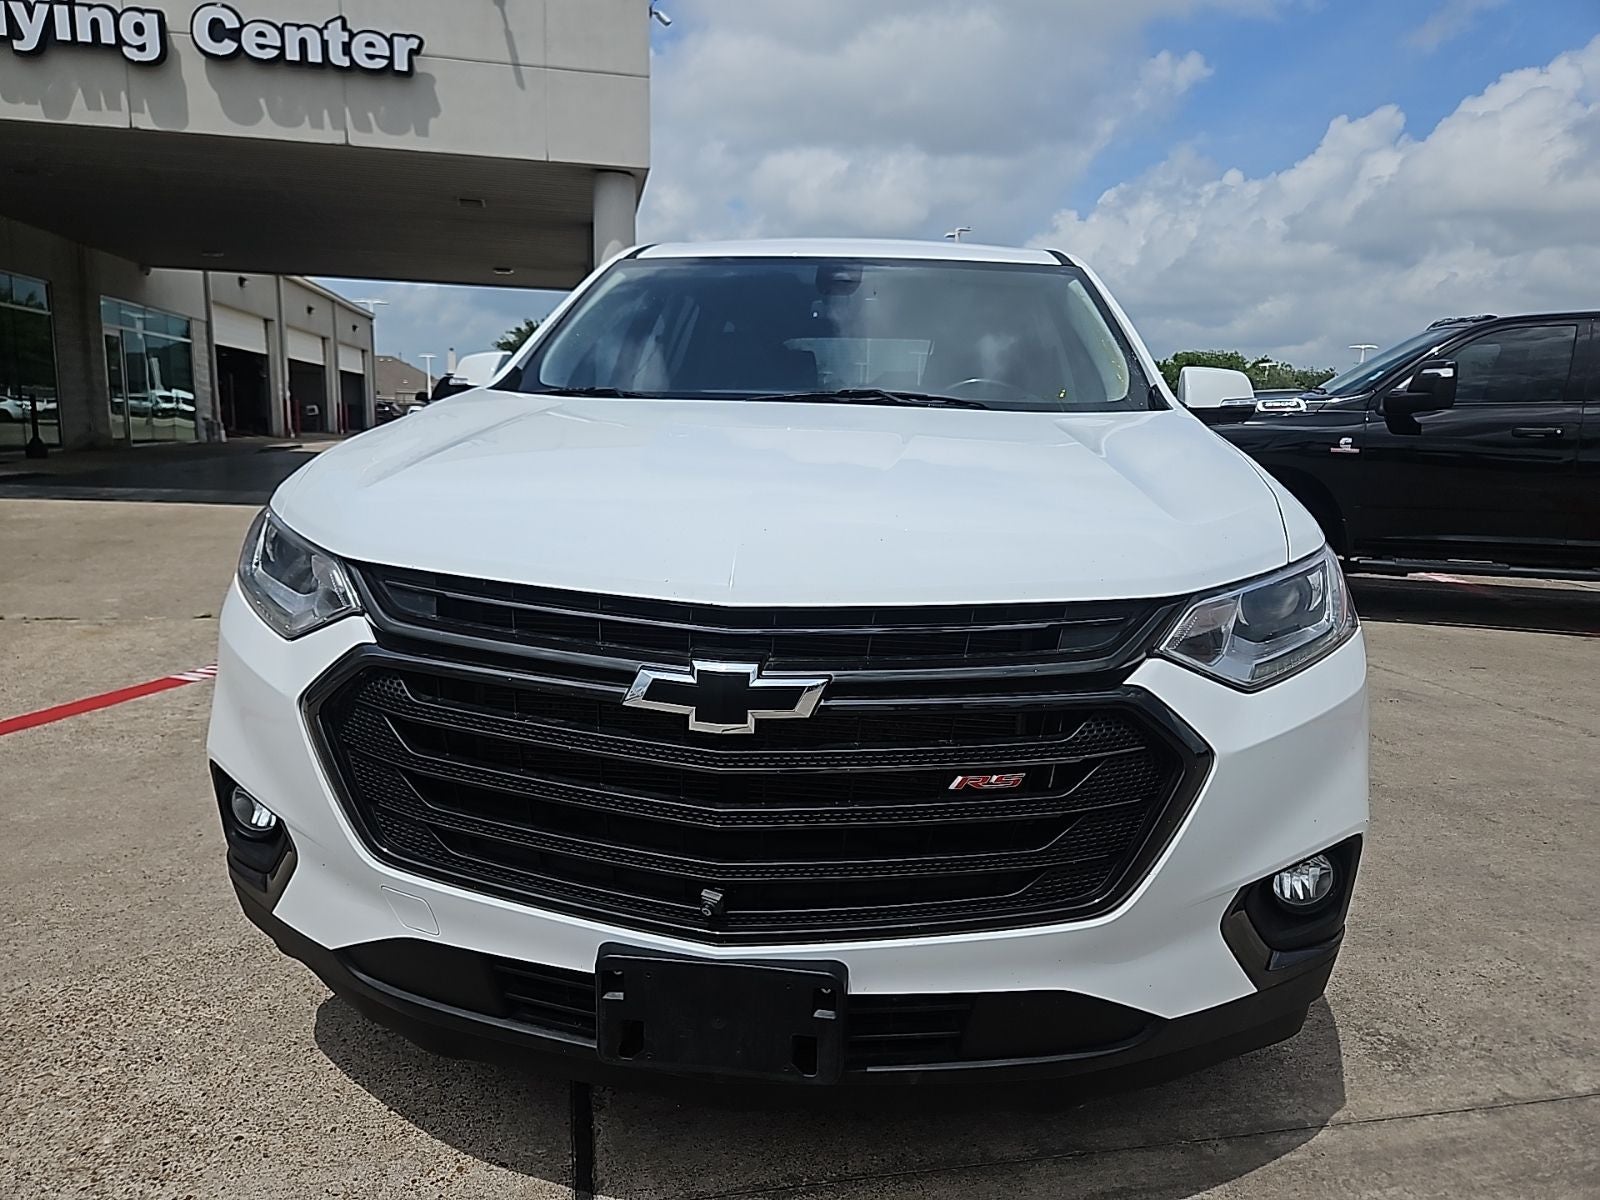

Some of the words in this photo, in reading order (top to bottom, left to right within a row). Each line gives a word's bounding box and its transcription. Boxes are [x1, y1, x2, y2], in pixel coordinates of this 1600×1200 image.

[0, 0, 163, 63] ying
[191, 3, 421, 73] Center
[948, 772, 1026, 790] RS
